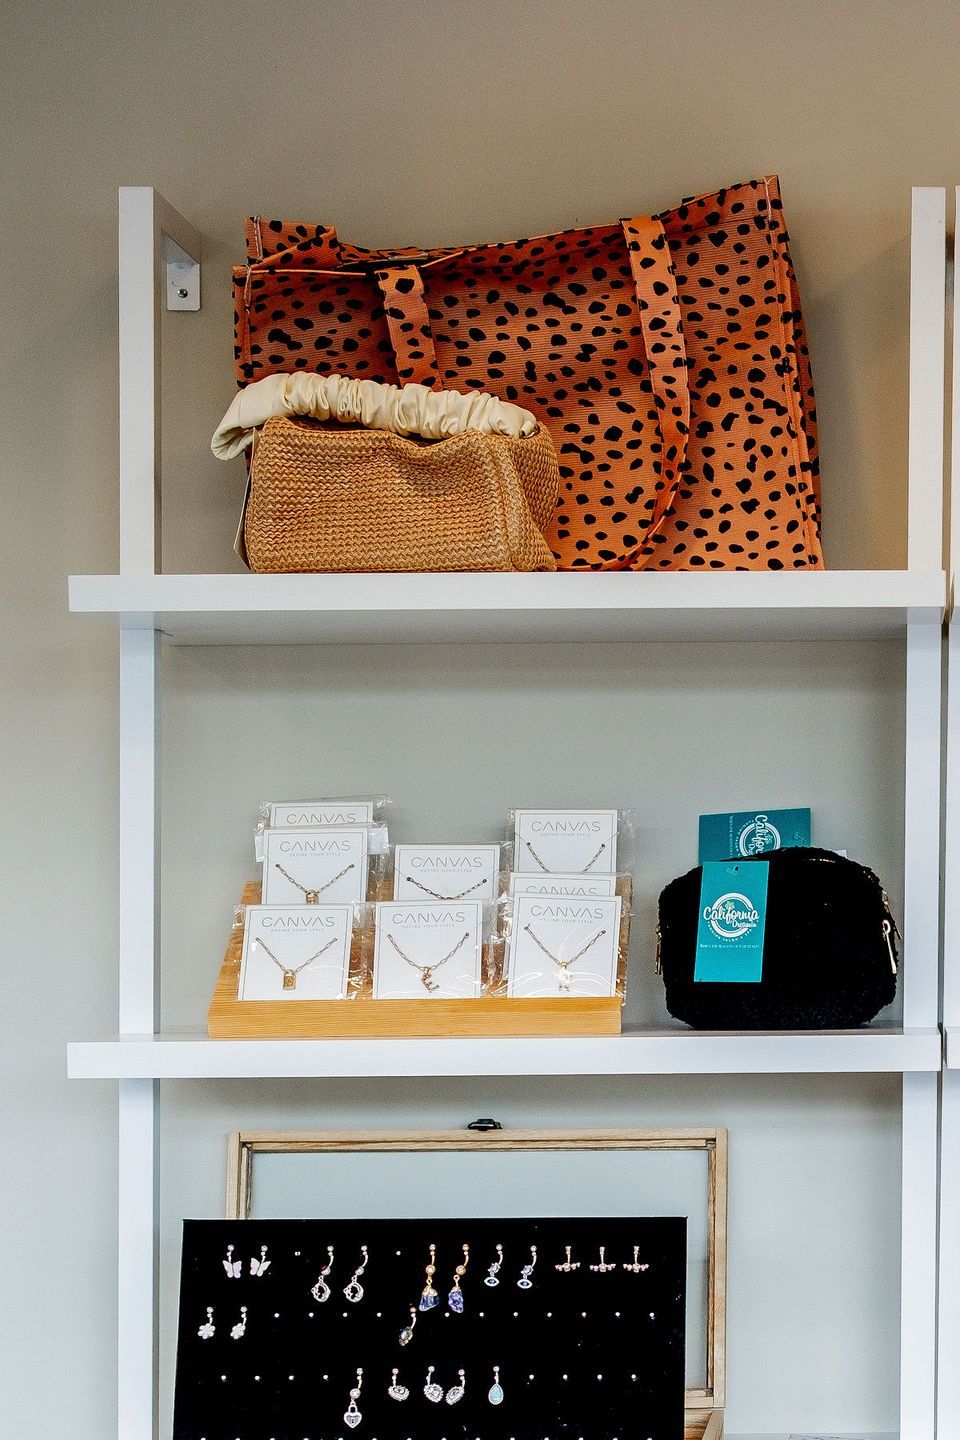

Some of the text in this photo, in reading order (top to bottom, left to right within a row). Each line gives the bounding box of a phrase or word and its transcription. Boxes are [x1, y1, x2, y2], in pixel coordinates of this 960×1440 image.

[286, 812, 357, 825] CANVAS
[531, 820, 601, 832] CANVAS
[751, 814, 769, 854] Califor
[279, 839, 351, 852] CANVAS
[411, 856, 483, 868] CANVAS
[392, 911, 466, 924] CANVAS
[530, 905, 604, 919] CANVAS
[703, 906, 760, 925] California
[261, 916, 335, 928] CANVAS
